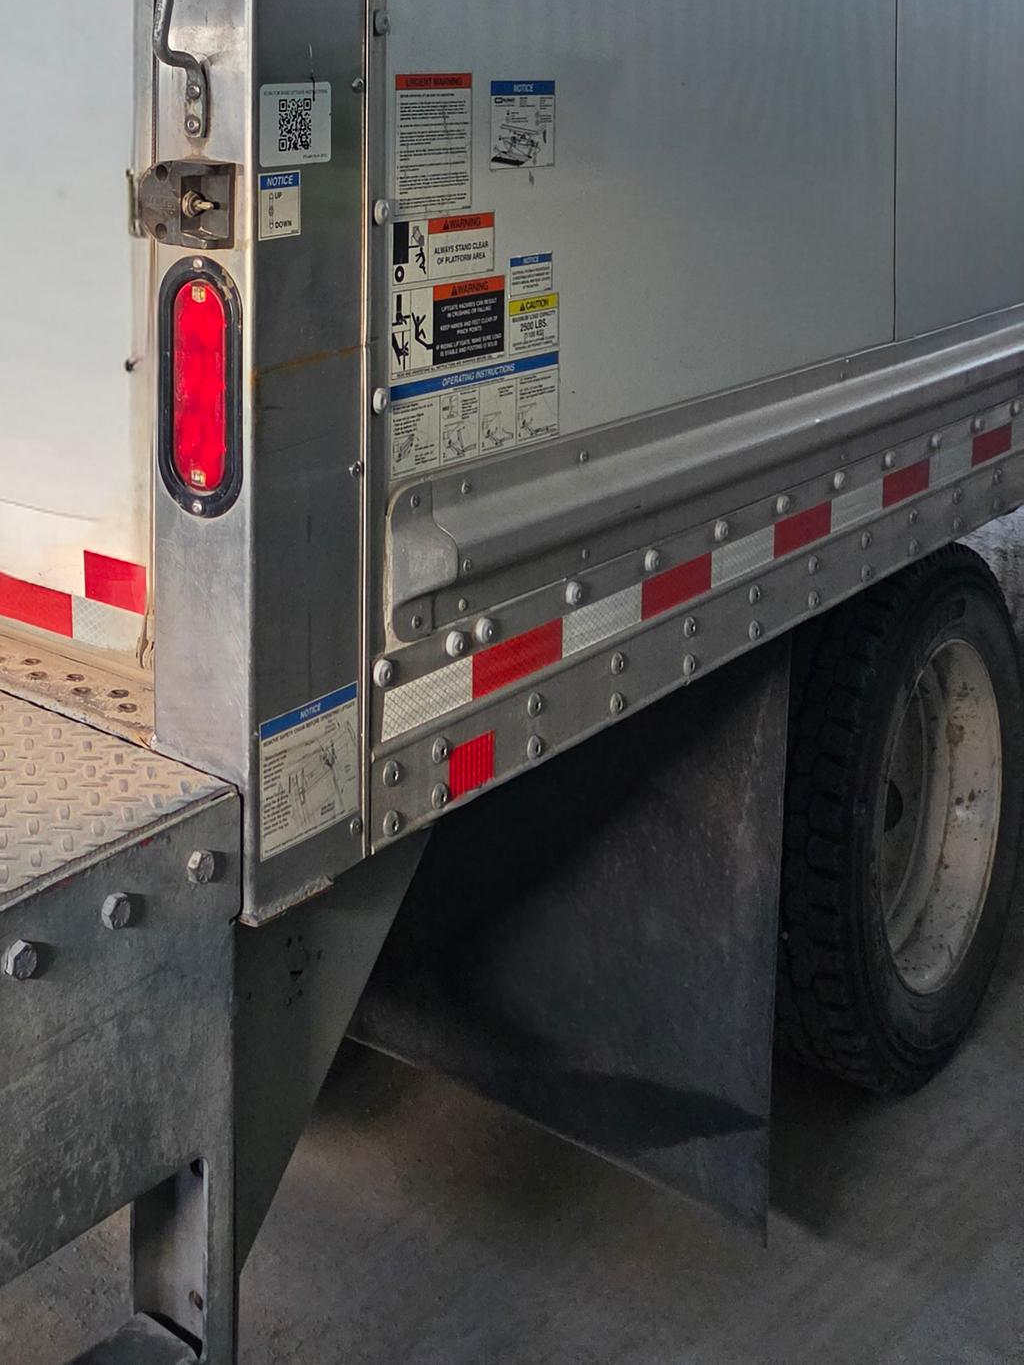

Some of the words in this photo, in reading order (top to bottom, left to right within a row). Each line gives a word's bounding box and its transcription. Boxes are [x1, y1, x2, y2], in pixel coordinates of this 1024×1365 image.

[514, 84, 534, 93] NOTICE
[266, 175, 294, 187] NOTICE
[275, 192, 282, 200] UP
[275, 220, 292, 229] DOWN
[449, 218, 480, 229] WARNING
[434, 246, 454, 255] ALWAYS
[455, 244, 472, 252] STAND
[472, 241, 489, 249] CLEAR
[445, 254, 472, 265] PLATFORM
[472, 252, 486, 260] AREA
[458, 281, 489, 294] WARNING
[526, 299, 549, 310] CAUTION
[520, 321, 534, 332] 2500
[535, 318, 548, 329] LBS.
[442, 372, 474, 387] OPERATING
[476, 363, 515, 381] INSTRUCTIONS
[300, 702, 321, 719] NOTICE
